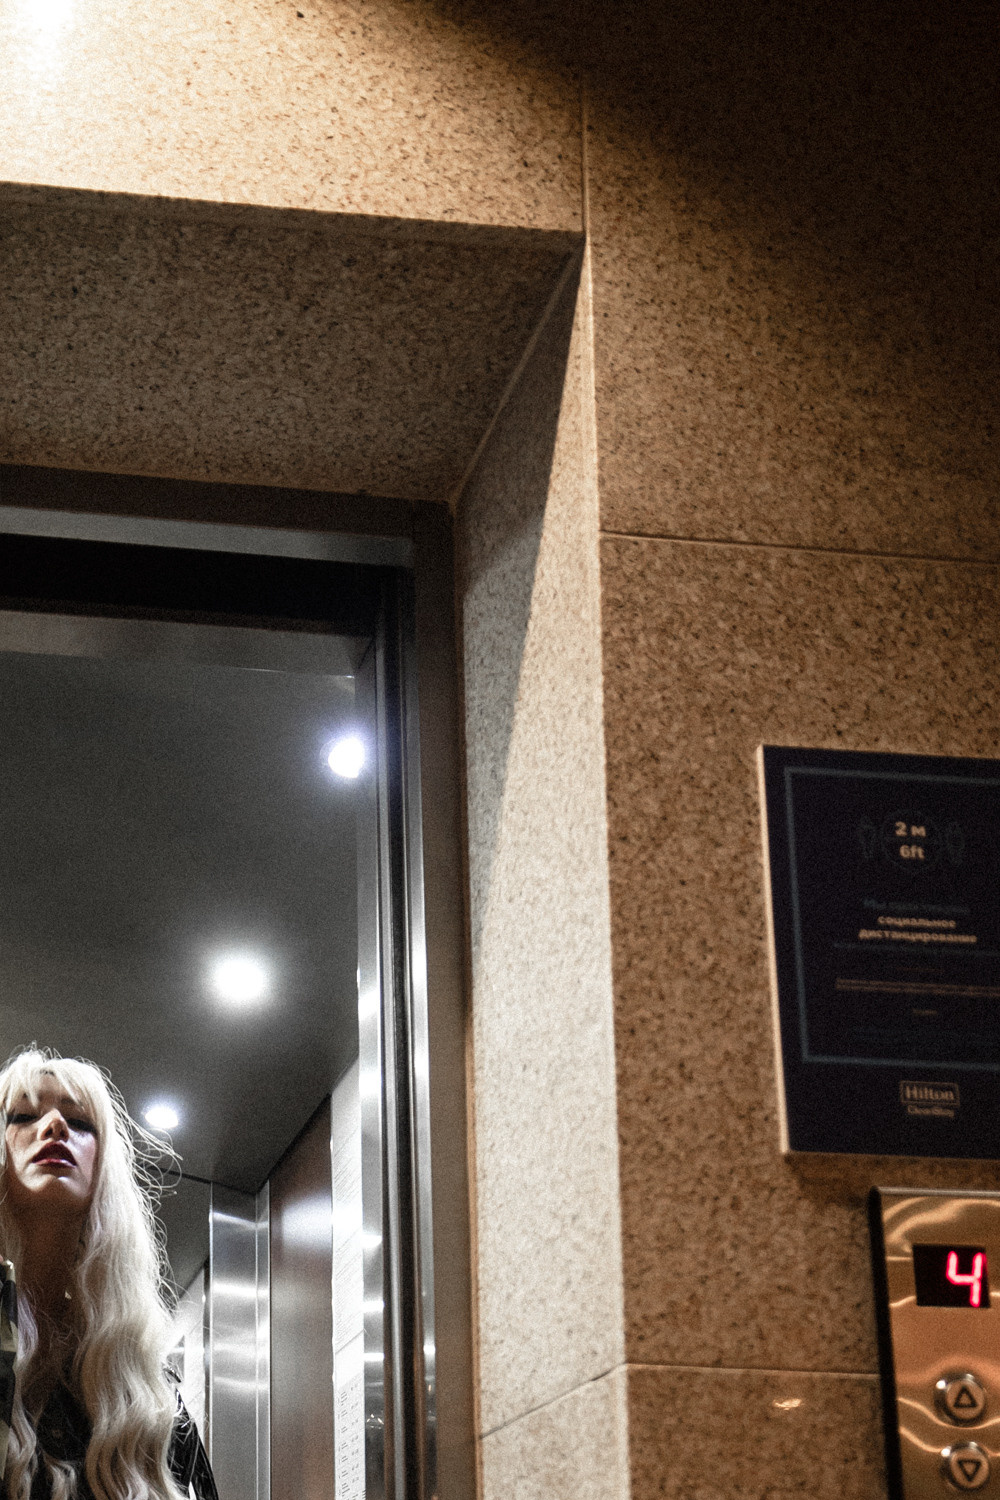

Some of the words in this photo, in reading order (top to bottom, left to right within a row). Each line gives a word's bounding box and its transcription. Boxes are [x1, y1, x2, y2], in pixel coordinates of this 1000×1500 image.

[894, 821, 908, 837] 2
[899, 844, 925, 860] 6ft
[906, 1085, 955, 1101] Hilton
[946, 1251, 985, 1307] 4
